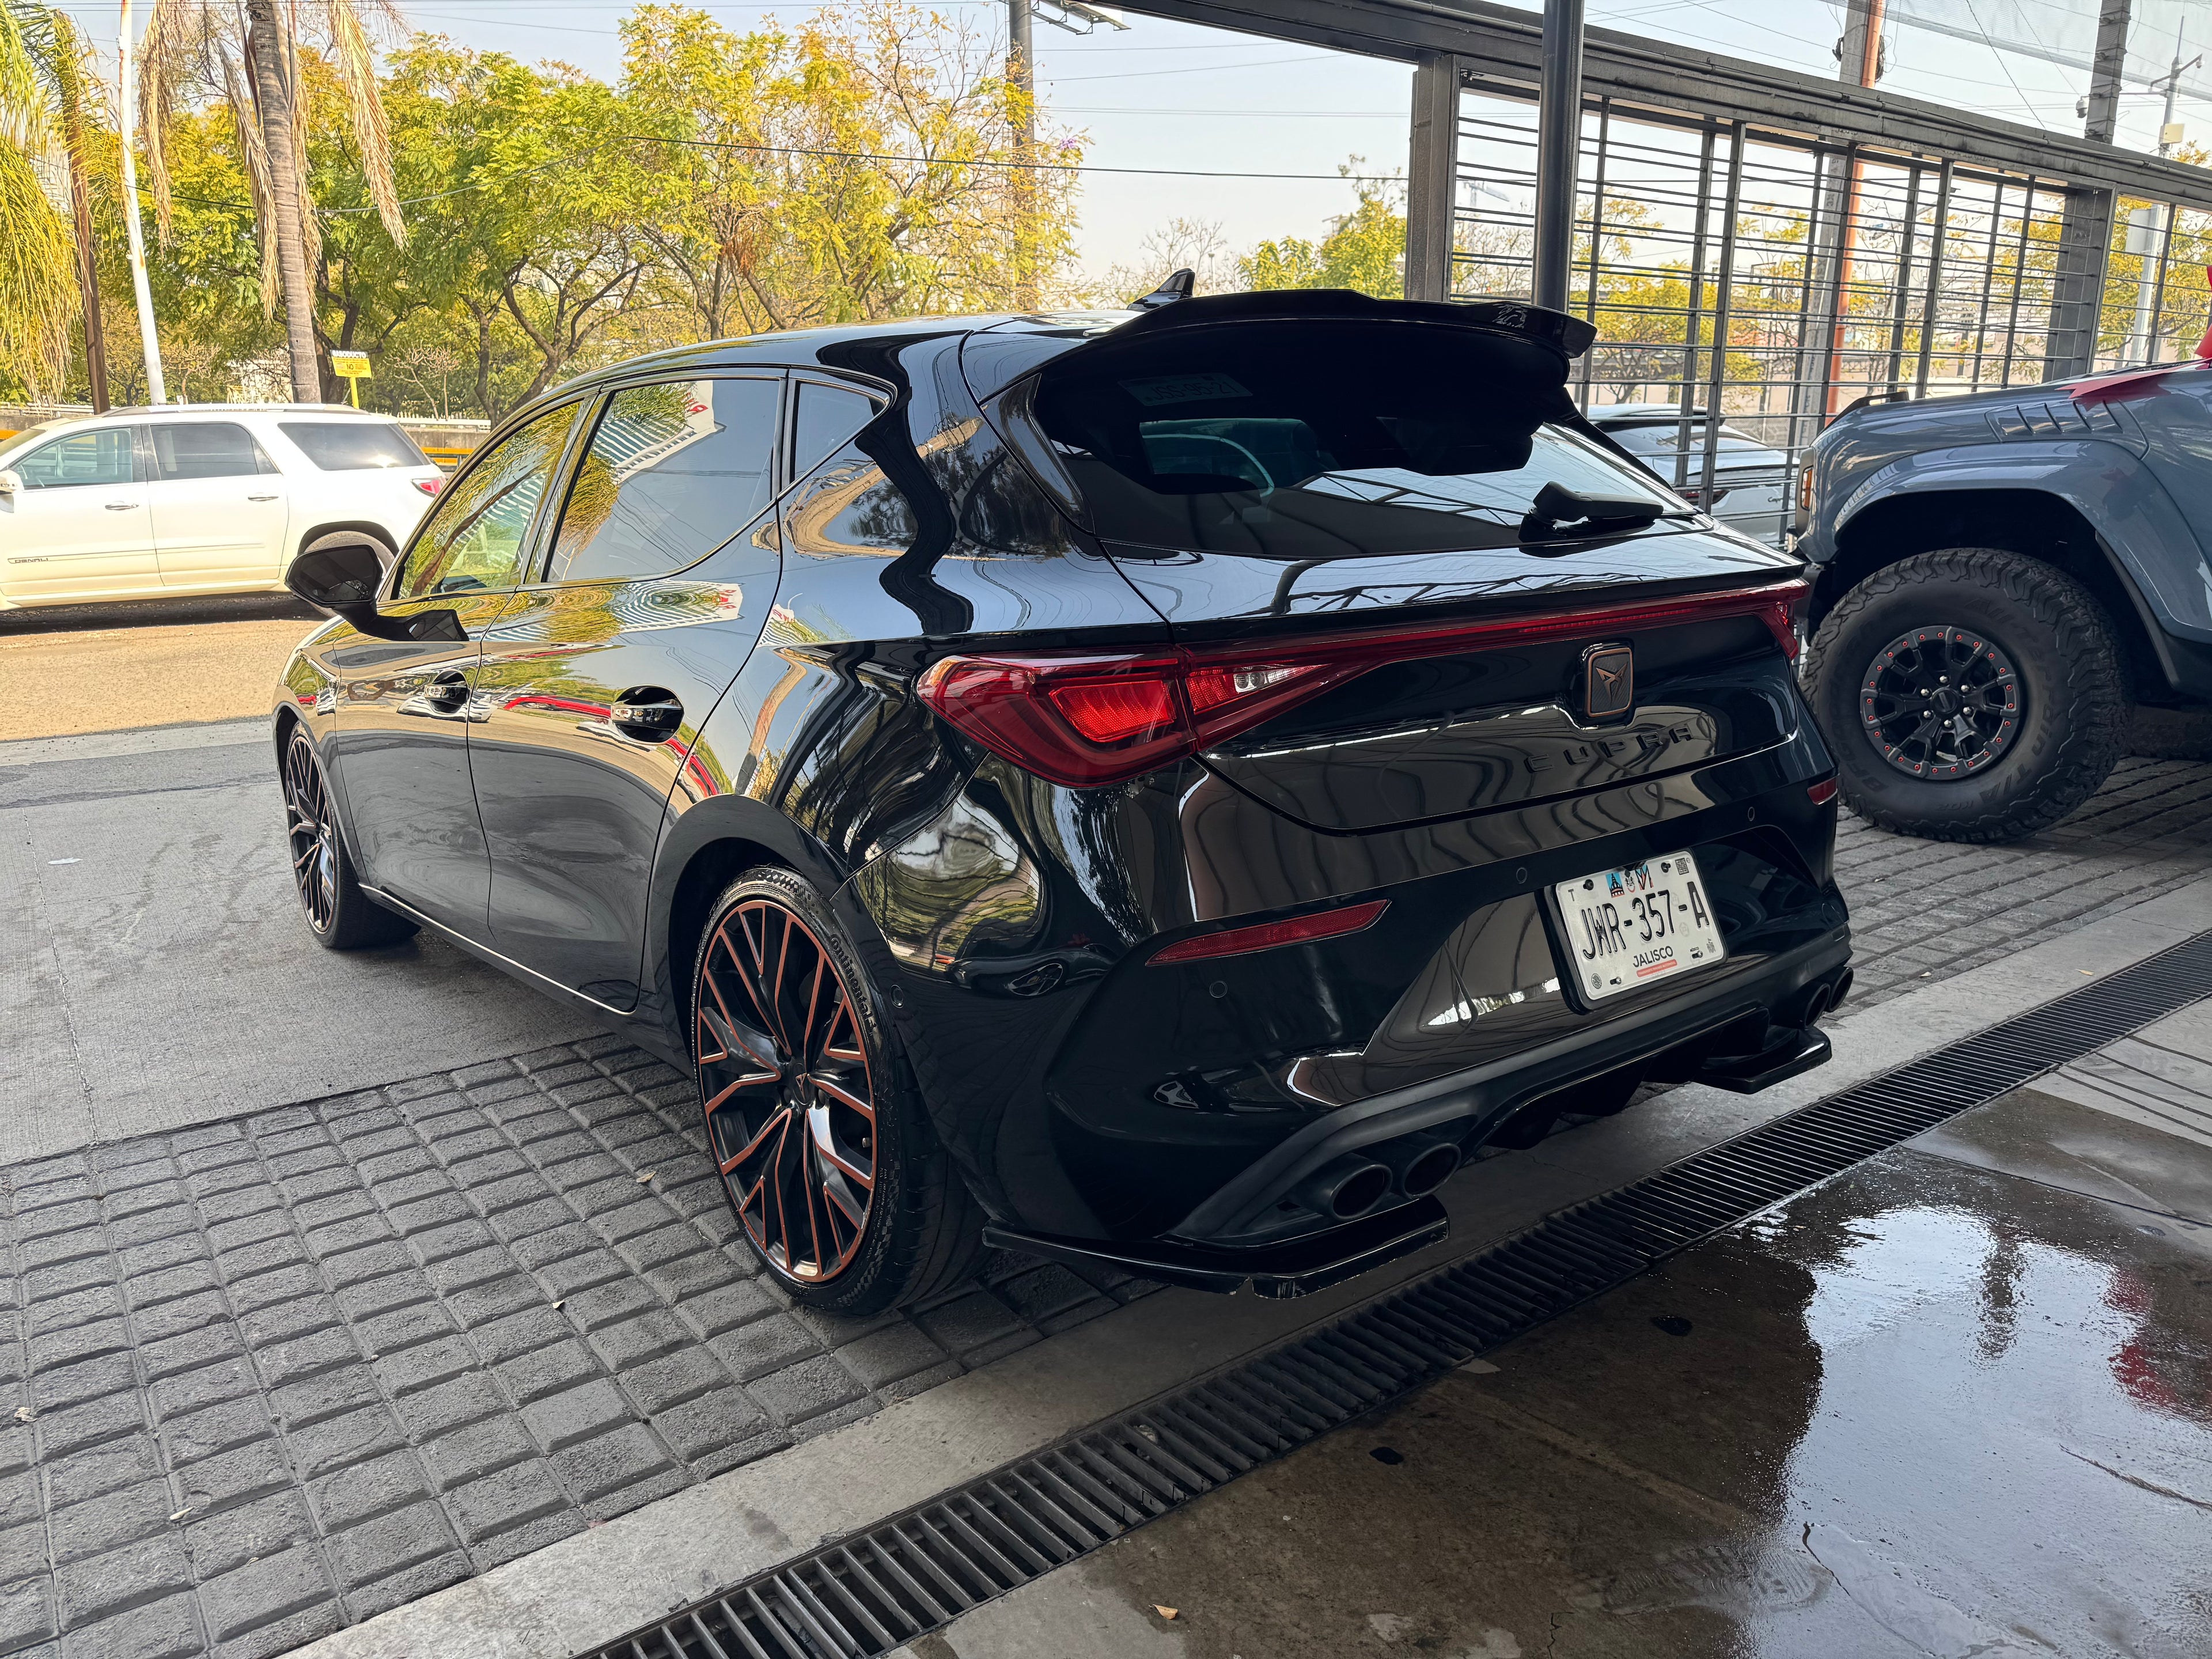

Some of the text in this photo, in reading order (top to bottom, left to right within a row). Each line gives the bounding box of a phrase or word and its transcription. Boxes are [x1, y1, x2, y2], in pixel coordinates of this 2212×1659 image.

[1524, 724, 1694, 774] CUPRA
[1581, 881, 1710, 960] JWR-357-A
[831, 936, 873, 1020] Continental
[1633, 946, 1673, 967] JALISCO
